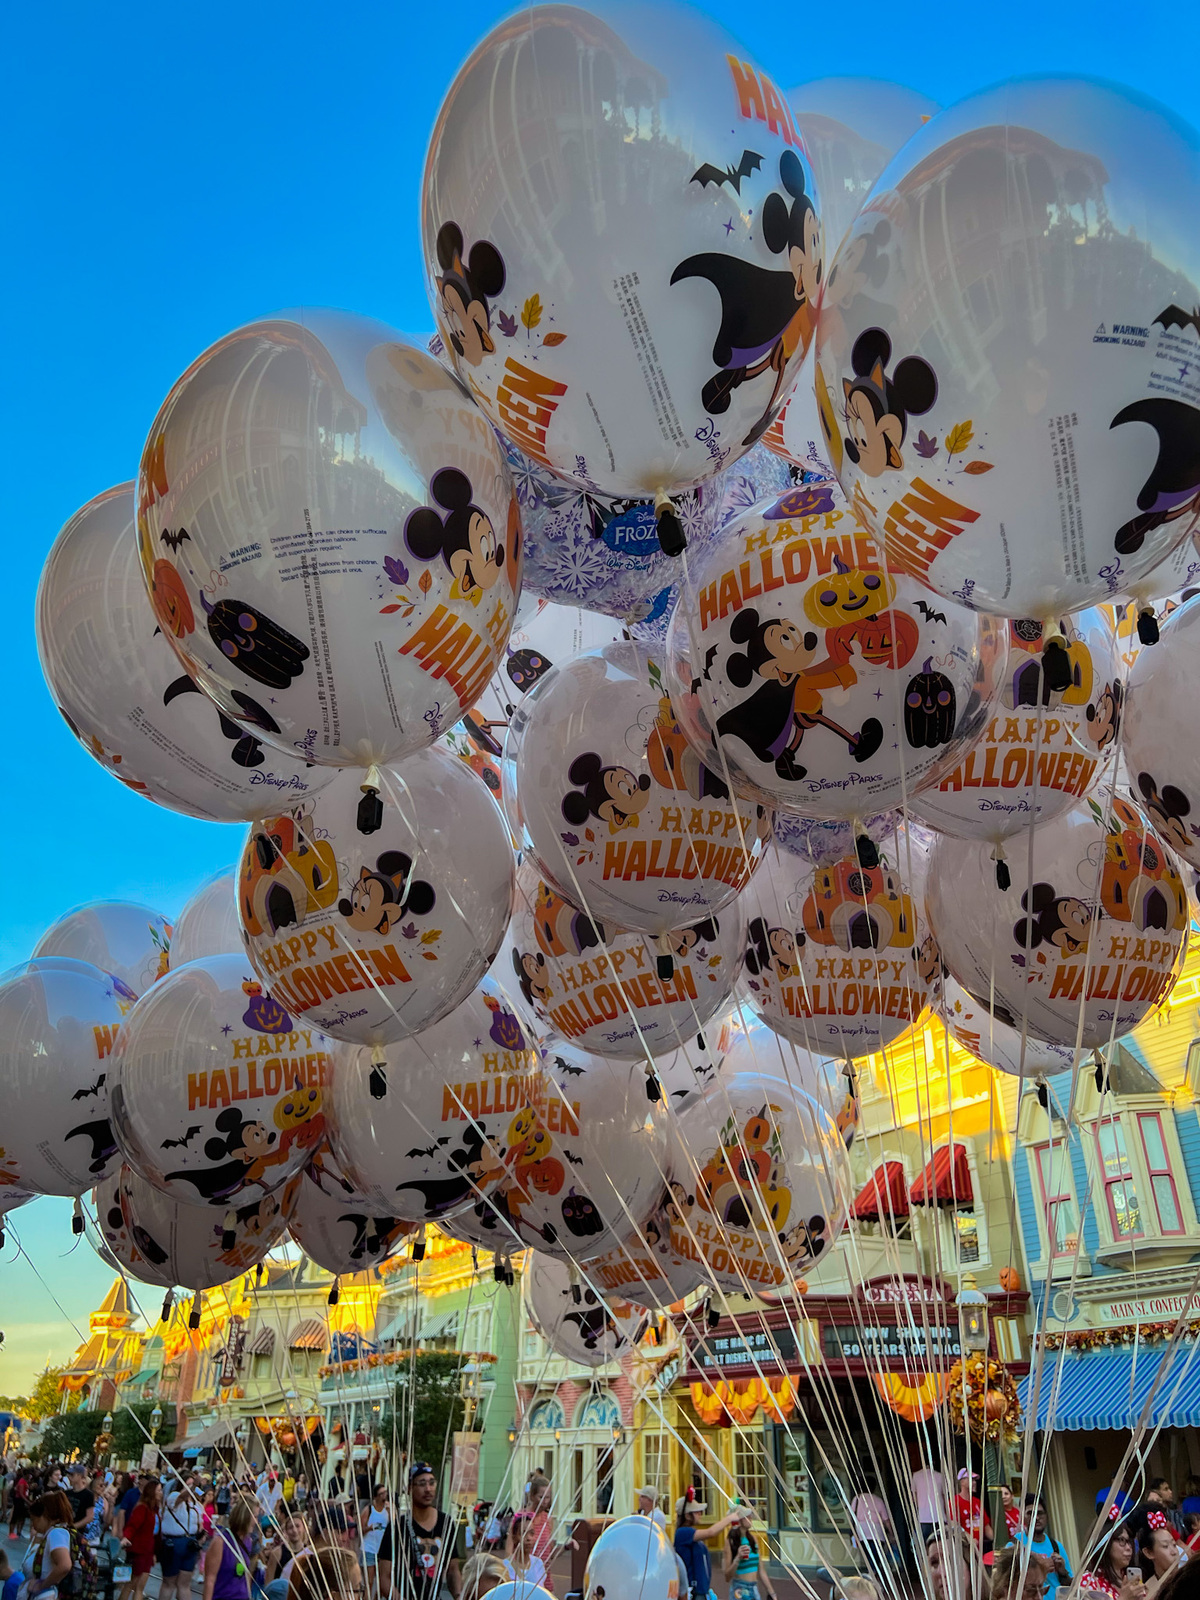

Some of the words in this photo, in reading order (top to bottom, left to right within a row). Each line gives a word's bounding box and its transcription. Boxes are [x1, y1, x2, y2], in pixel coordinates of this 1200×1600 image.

[1113, 324, 1150, 338] WARNING:
[1121, 338, 1146, 347] HAZARD
[270, 535, 292, 543] Children
[229, 542, 262, 559] WARNING:
[219, 559, 241, 572] CHOKING
[241, 552, 262, 564] HAZARD
[658, 806, 752, 838] HAPPY
[260, 924, 339, 975] HAPPY
[557, 944, 645, 993] HAPPY
[815, 958, 906, 981] HAPPY
[550, 965, 698, 1039] HALLOWEEN
[781, 982, 927, 1023] HALLOWEEN
[232, 1029, 312, 1060] HAPPY
[696, 1220, 771, 1258] HAPPY
[865, 1288, 943, 1302] CINEMA
[1110, 1302, 1135, 1319] MAIN
[1135, 1301, 1149, 1315] ST.
[843, 1344, 860, 1355] 50
